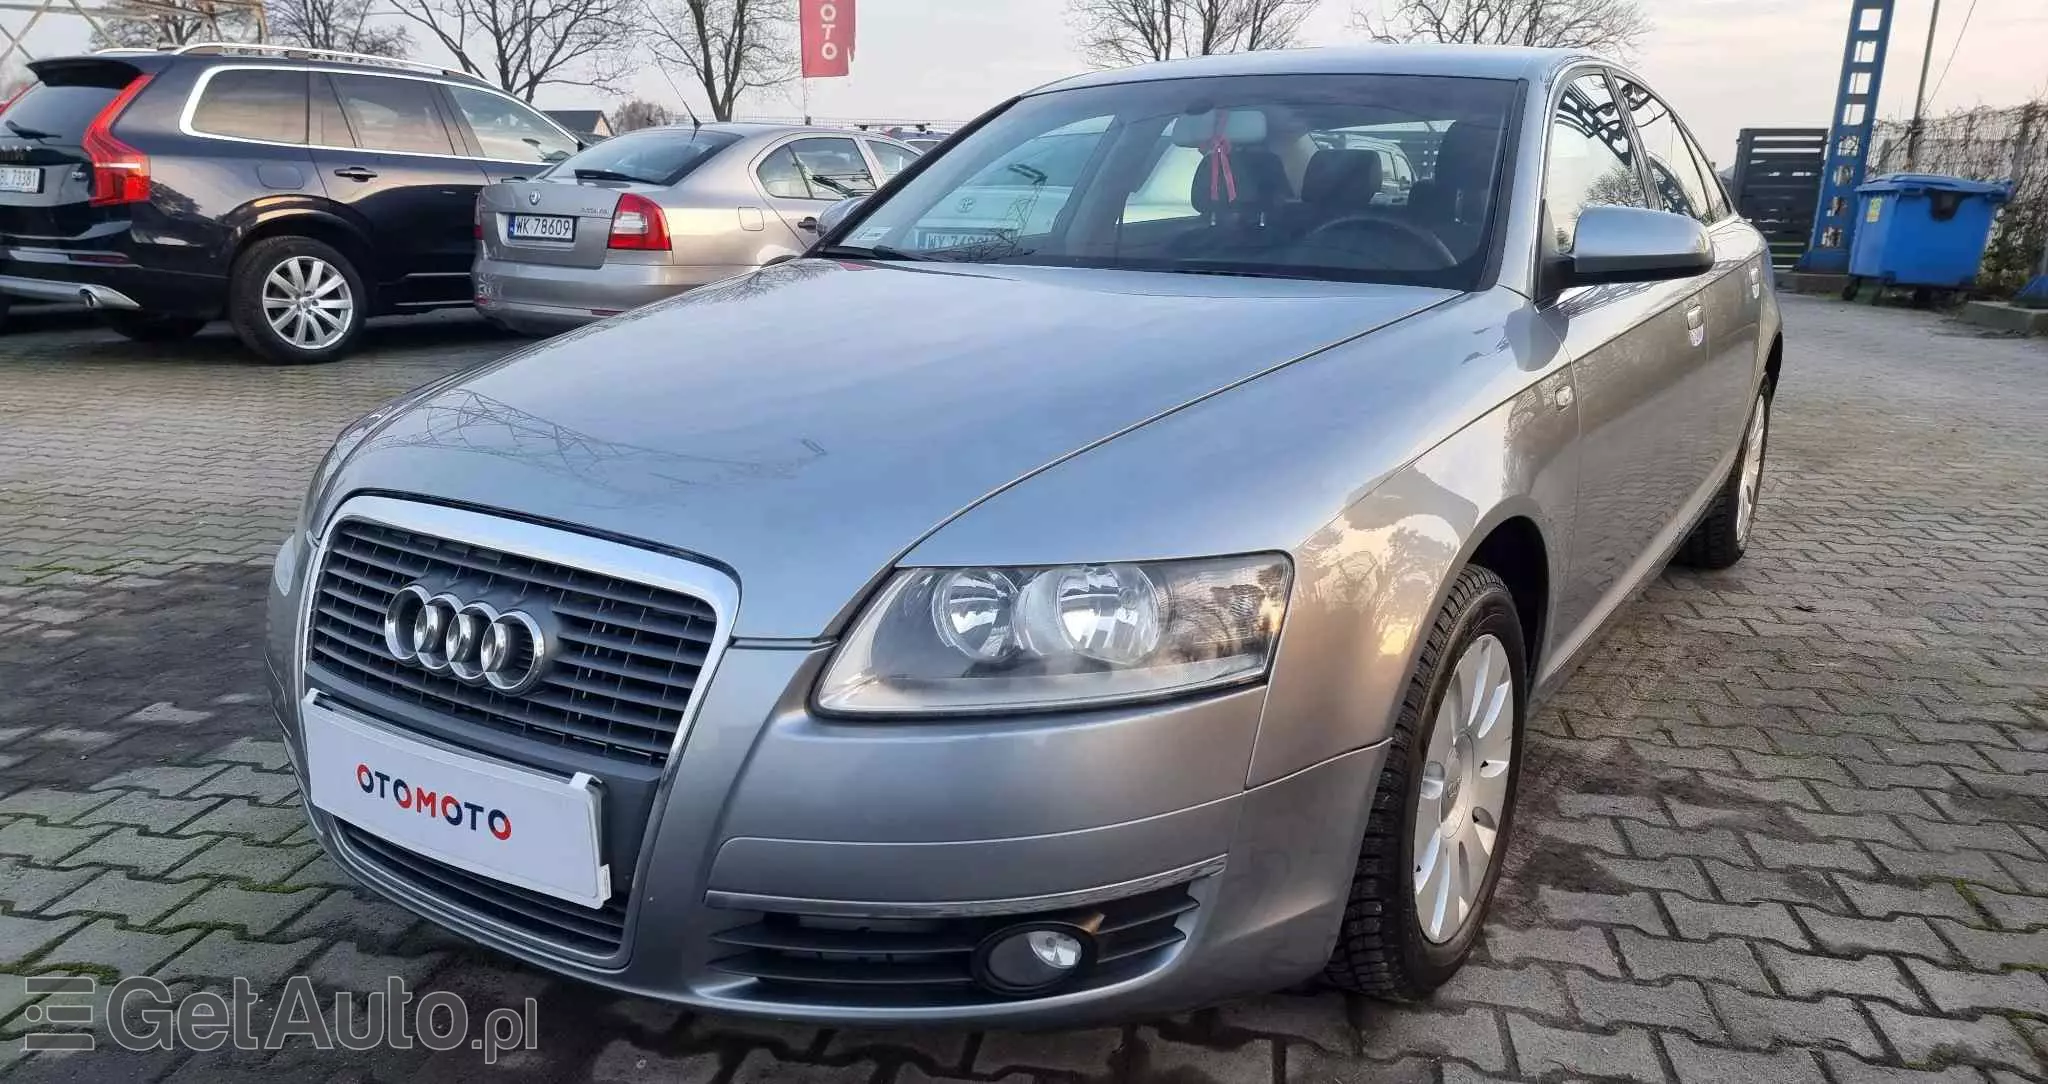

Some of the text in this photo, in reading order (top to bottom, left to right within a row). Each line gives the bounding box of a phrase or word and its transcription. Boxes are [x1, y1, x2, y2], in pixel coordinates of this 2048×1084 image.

[820, 0, 837, 60] OTO
[516, 216, 570, 236] WK 78609
[357, 764, 512, 841] OTOMOTO
